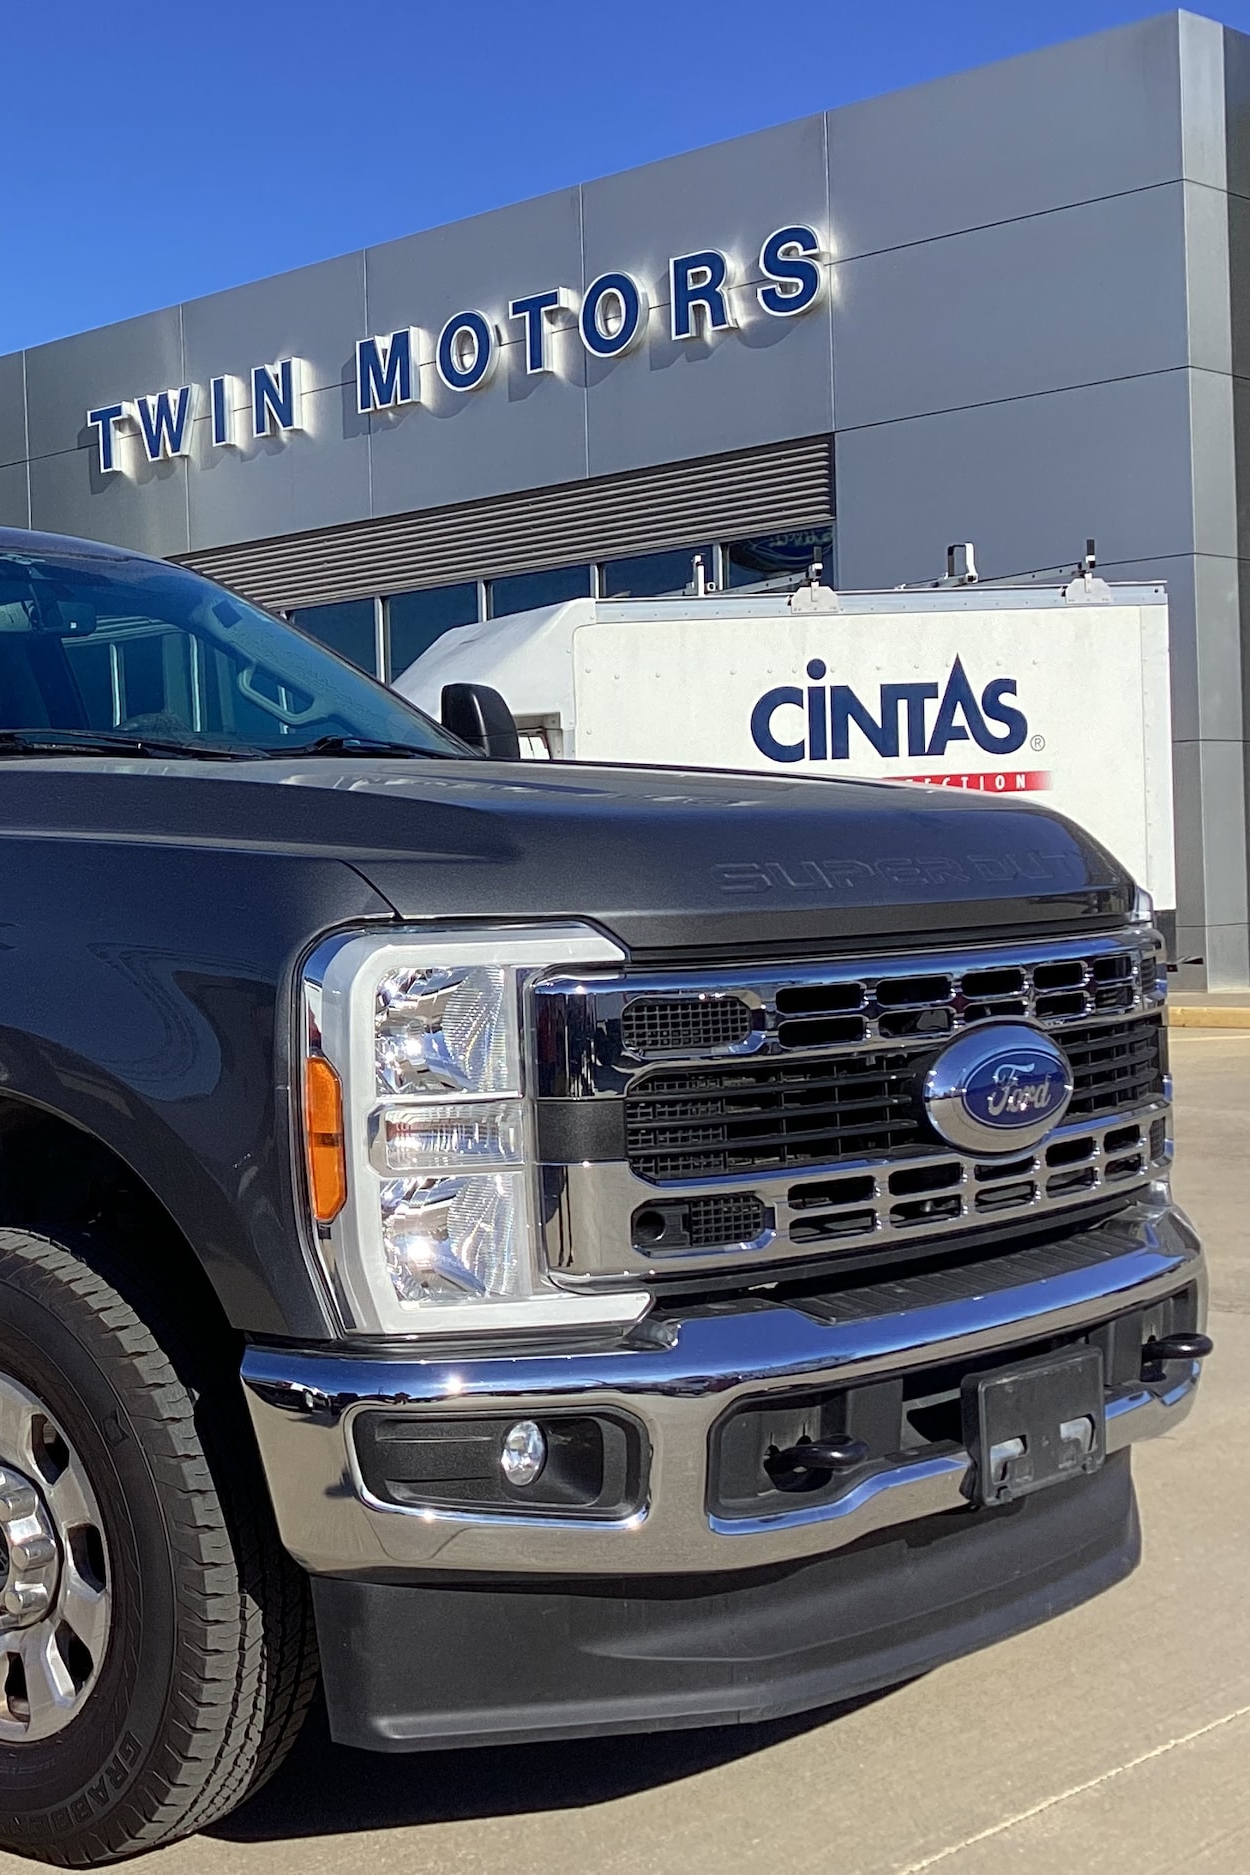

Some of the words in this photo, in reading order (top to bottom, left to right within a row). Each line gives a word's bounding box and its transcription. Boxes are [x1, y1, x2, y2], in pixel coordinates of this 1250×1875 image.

[87, 356, 302, 473] TWIN
[355, 223, 828, 414] MOTORS
[987, 1062, 1052, 1116] Ford
